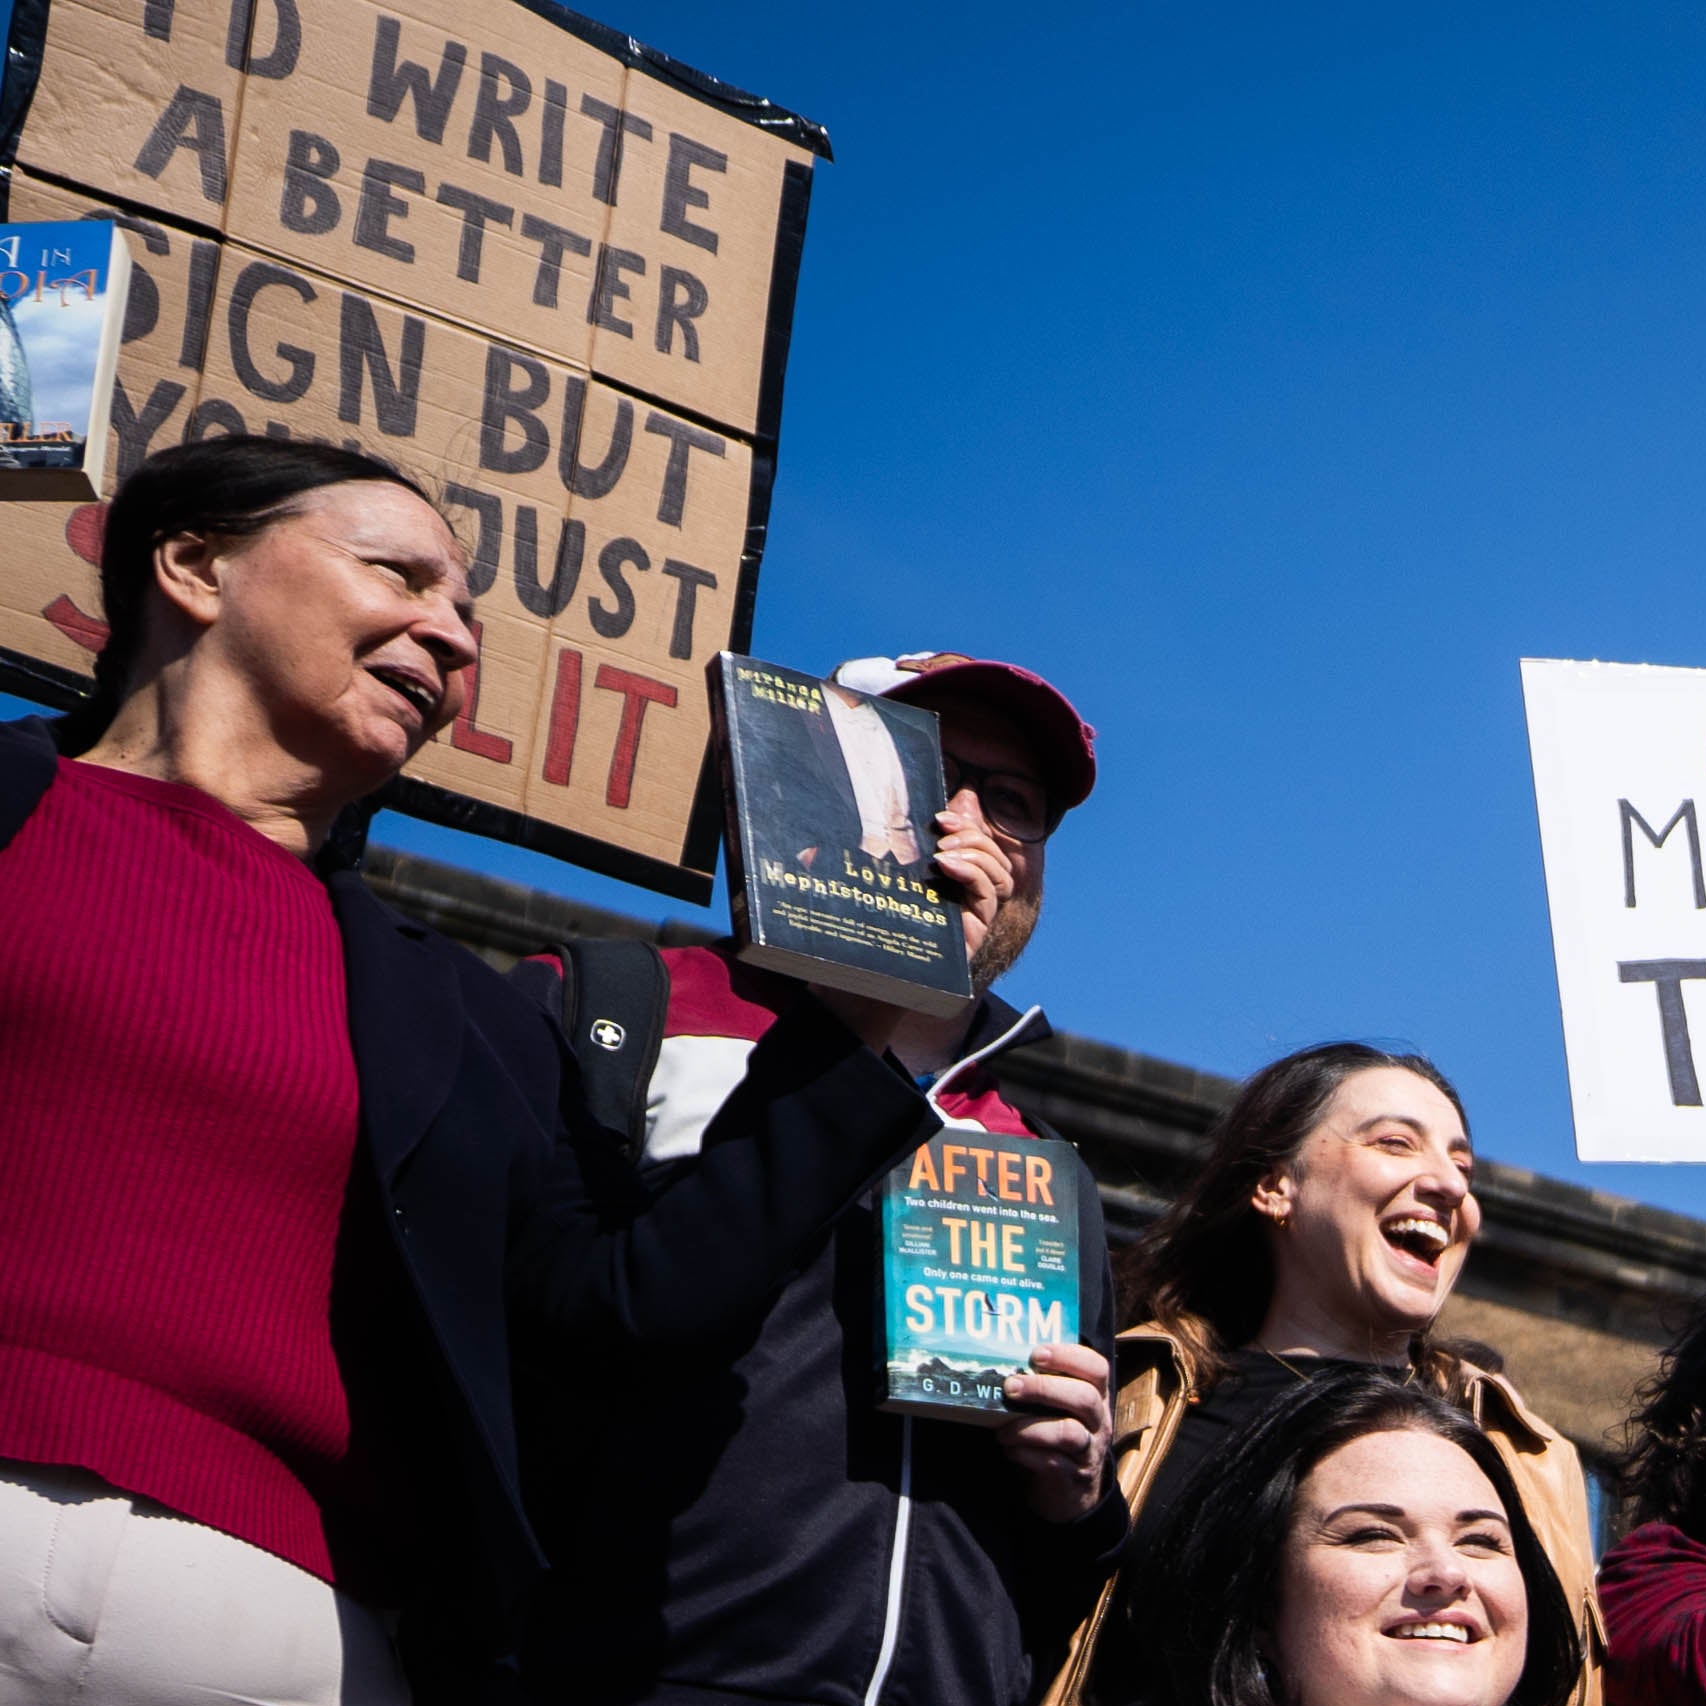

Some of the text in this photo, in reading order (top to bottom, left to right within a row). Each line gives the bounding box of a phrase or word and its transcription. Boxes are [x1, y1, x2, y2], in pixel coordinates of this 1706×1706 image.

[367, 15, 728, 255] WRITE
[133, 83, 709, 364] A BETTER
[480, 342, 726, 531] BUT
[545, 648, 678, 809] IT
[764, 863, 948, 928] Mephistopheles
[845, 860, 940, 904] Loving
[908, 1144, 1055, 1206] AFTER
[903, 1196, 1060, 1224] Two children went into the sea.
[942, 1217, 1026, 1273] THE
[923, 1266, 1046, 1290] Only one came out alive.
[905, 1284, 1063, 1346] STORM
